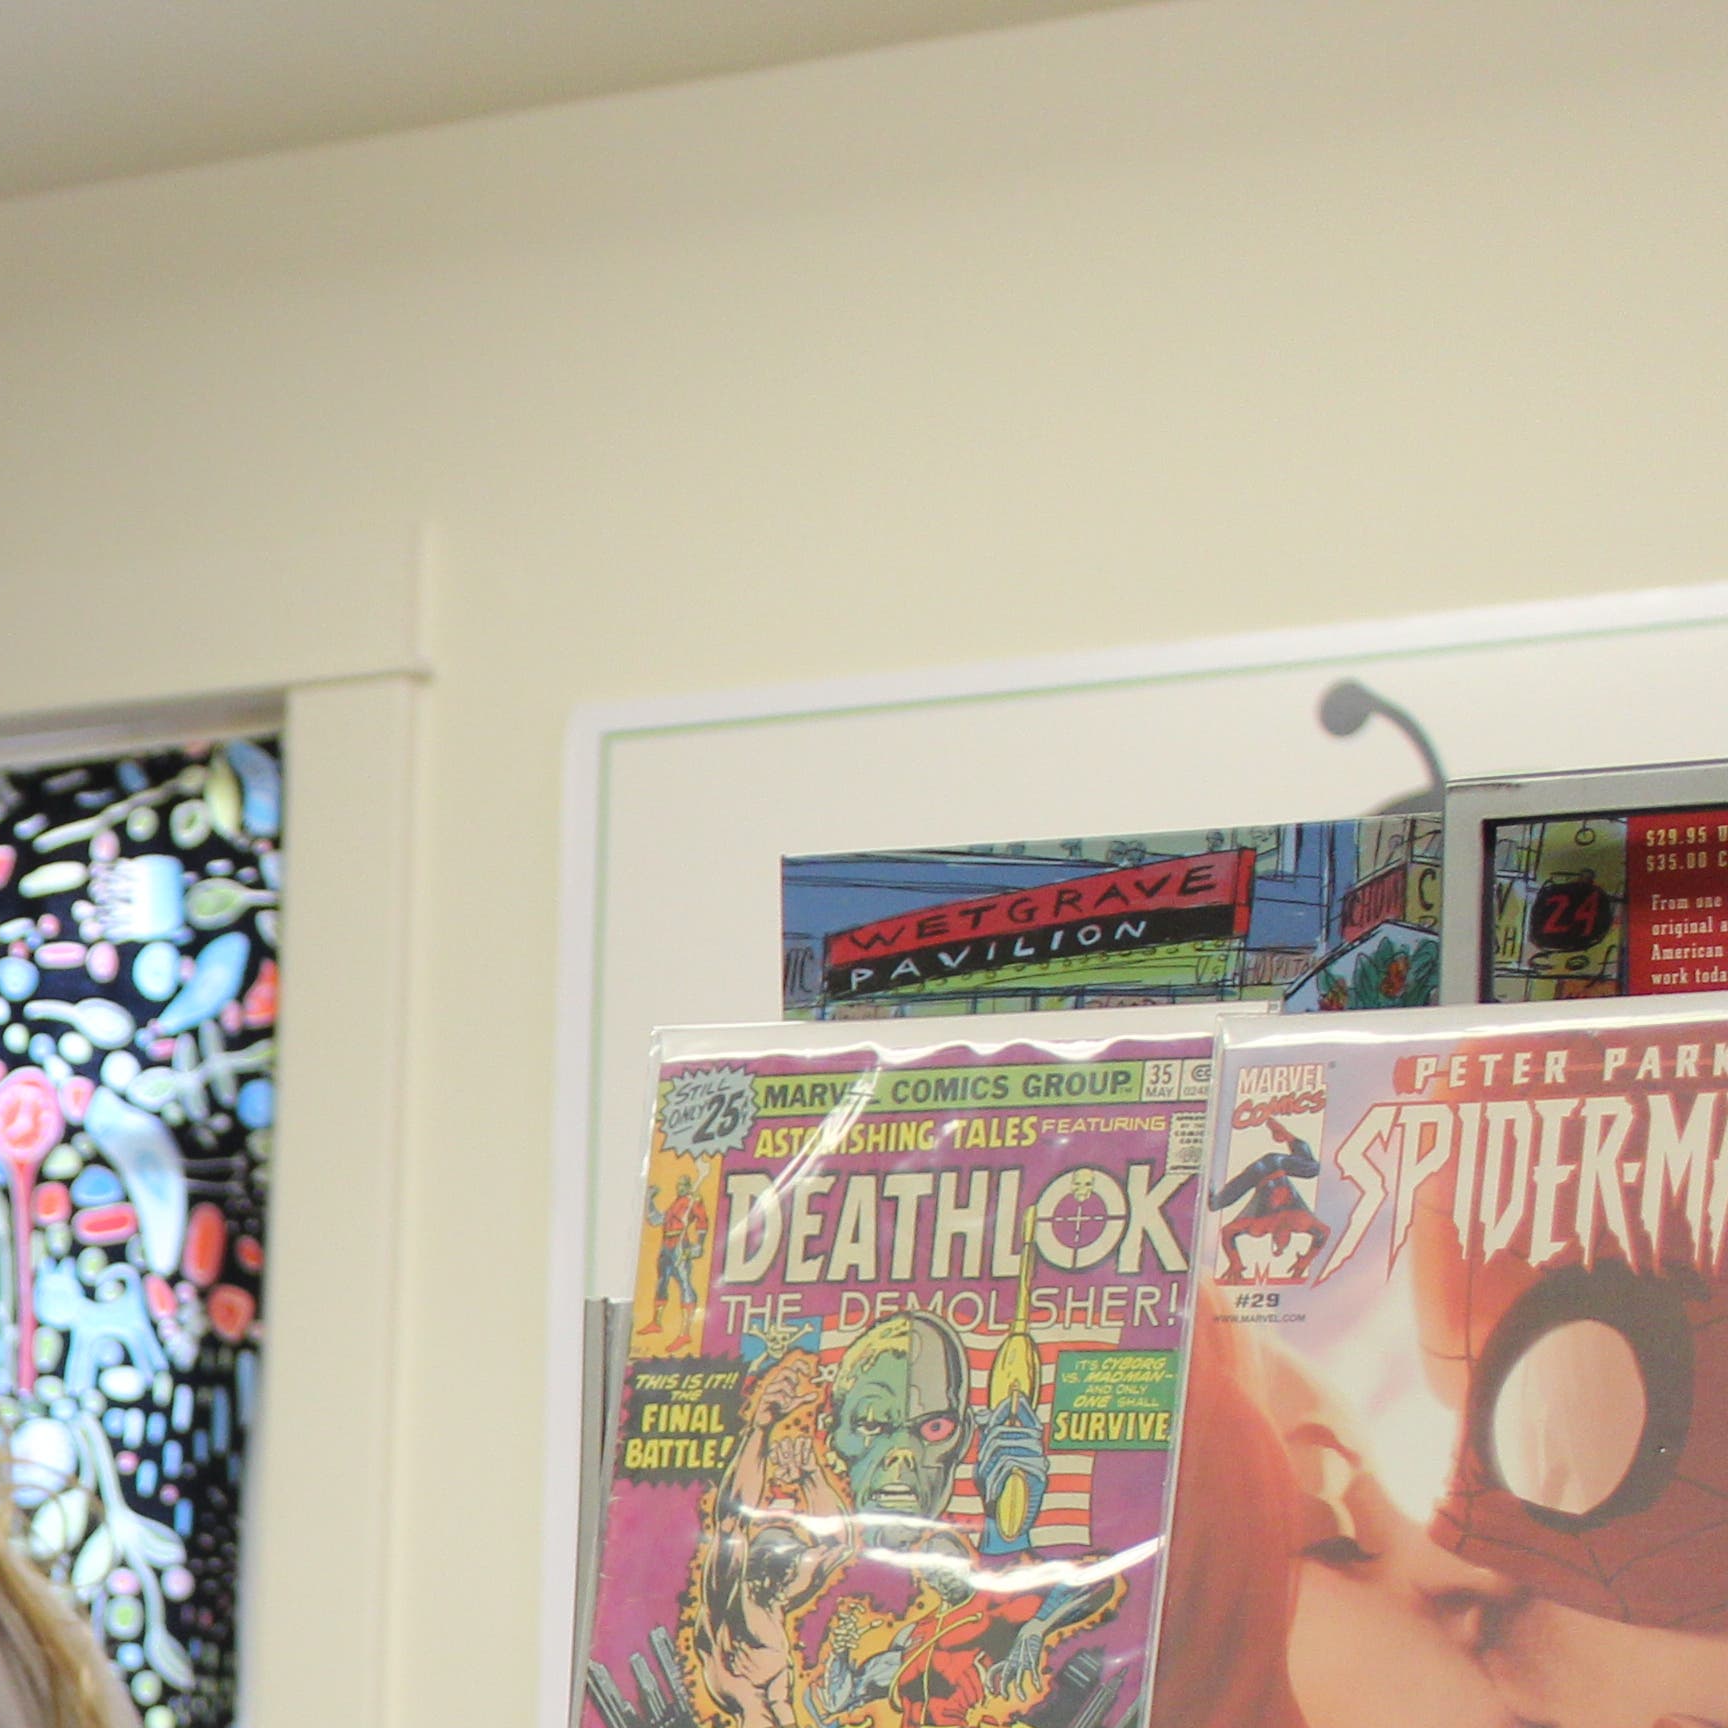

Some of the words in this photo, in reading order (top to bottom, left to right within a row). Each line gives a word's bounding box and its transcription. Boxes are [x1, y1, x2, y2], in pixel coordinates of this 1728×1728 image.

[1646, 826, 1708, 848] $29.95
[1646, 850, 1708, 873] $35.00
[849, 863, 1218, 952] WETGRAVE
[1650, 893, 1689, 911] From
[1695, 895, 1723, 910] one
[1651, 915, 1714, 939] original
[849, 920, 1148, 993] PAVILION
[1650, 943, 1725, 962] American
[1650, 965, 1689, 986] work
[1149, 1063, 1173, 1085] 35
[1413, 1050, 1569, 1090] PETER
[1603, 1042, 1728, 1082] PARK
[763, 1076, 880, 1109] MARV
[890, 1073, 1010, 1105] COMICS
[1021, 1068, 1132, 1100] GROUP
[1233, 1062, 1328, 1095] MARVEL
[674, 1078, 731, 1105] STILL
[1146, 1086, 1175, 1098] MAY
[668, 1102, 704, 1128] ONLY
[1232, 1090, 1327, 1130] COMICS
[754, 1119, 936, 1159] ASTISHING
[953, 1115, 1039, 1149] TALES
[1041, 1114, 1166, 1134] FEATURING
[720, 1162, 1191, 1289] DEATHLOK
[720, 1294, 806, 1338] THE
[838, 1281, 1181, 1338] DEMOLSHER!
[1234, 1292, 1281, 1309] #29
[1100, 1356, 1167, 1371] CYBORG
[634, 1372, 681, 1391] THIS
[680, 1372, 704, 1390] IS
[1085, 1384, 1114, 1395] AND
[1114, 1383, 1149, 1395] ONLY
[670, 1388, 704, 1402] THE
[1072, 1394, 1112, 1408] ONE
[640, 1402, 726, 1434] FINAL
[623, 1434, 737, 1470] BATTLE!
